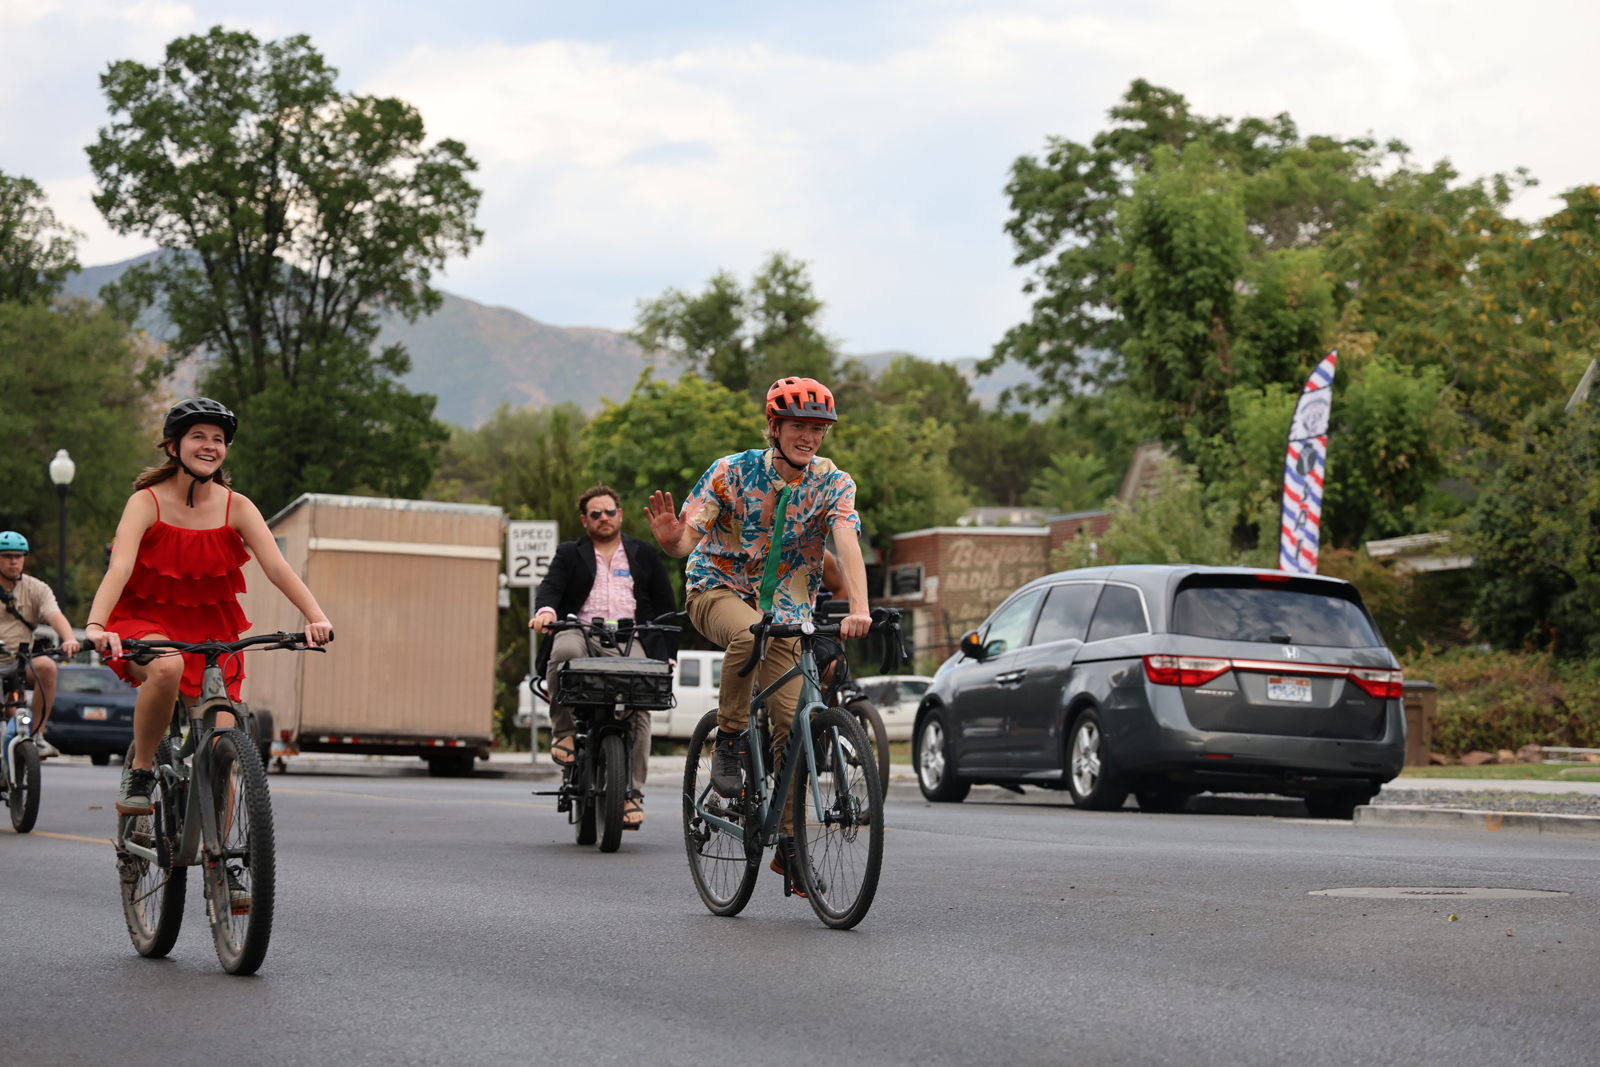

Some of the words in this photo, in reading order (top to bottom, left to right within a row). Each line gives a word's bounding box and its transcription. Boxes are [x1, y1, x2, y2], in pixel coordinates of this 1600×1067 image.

[512, 528, 553, 539] SPEED
[516, 542, 548, 552] LIMIT
[515, 556, 550, 577] 25
[944, 570, 1000, 591] RADIO
